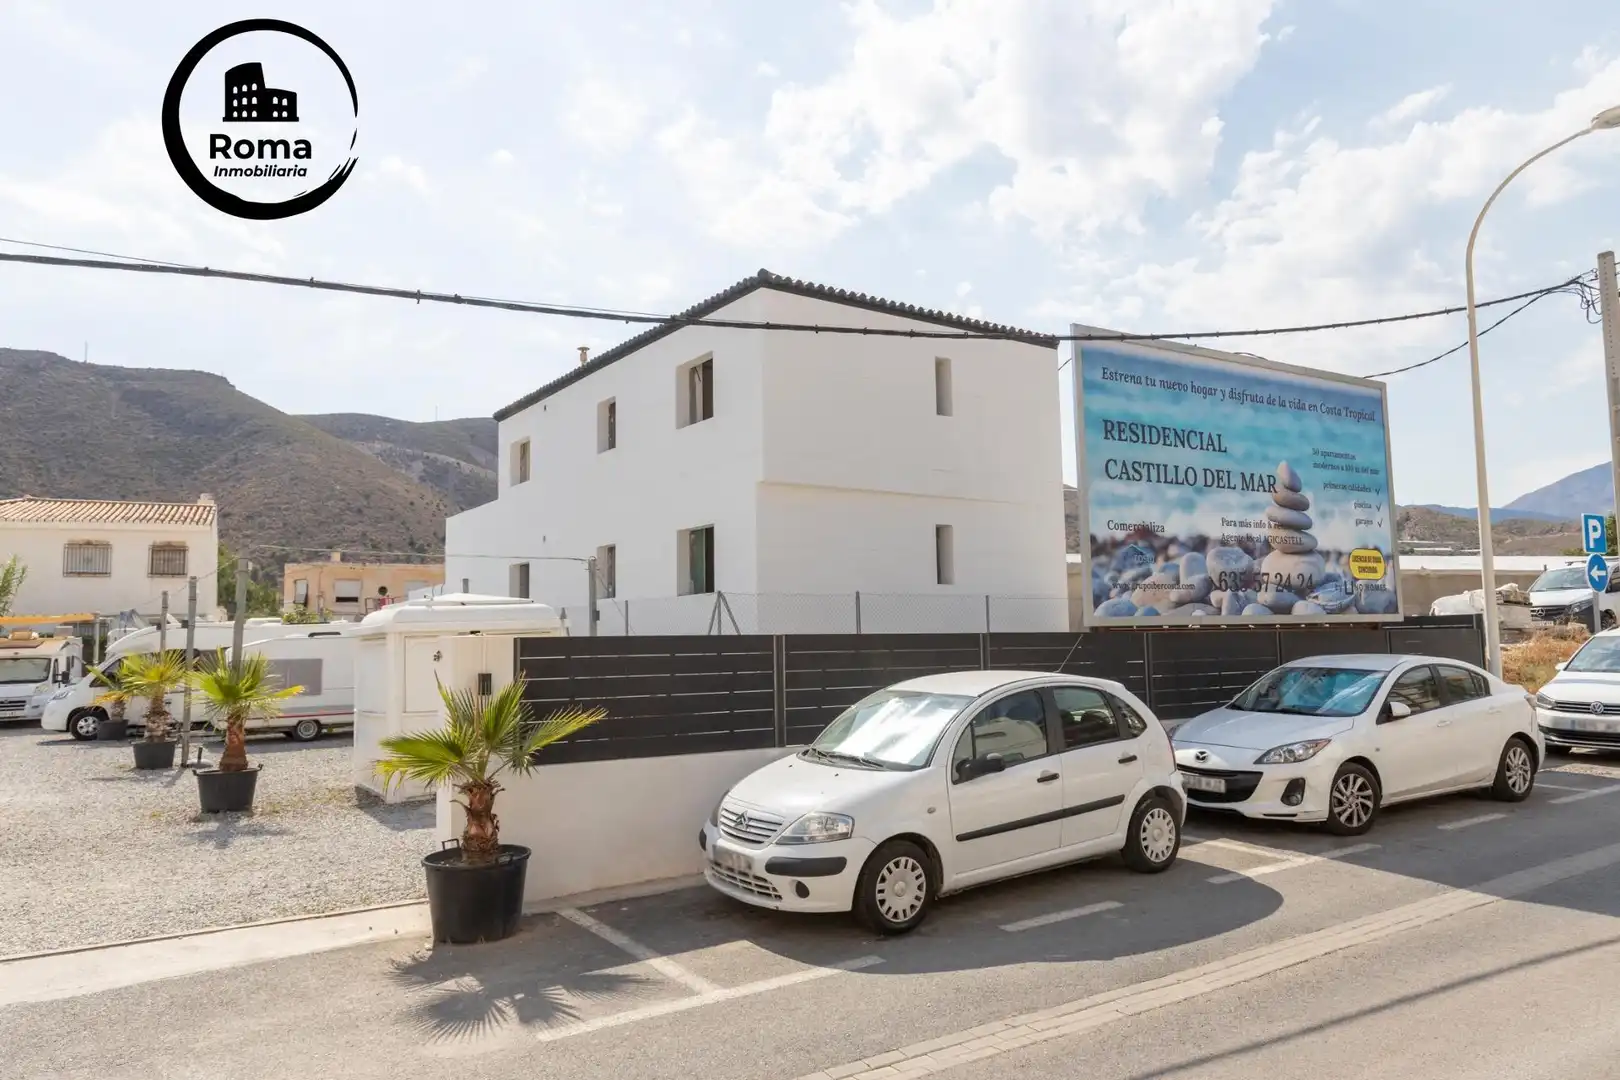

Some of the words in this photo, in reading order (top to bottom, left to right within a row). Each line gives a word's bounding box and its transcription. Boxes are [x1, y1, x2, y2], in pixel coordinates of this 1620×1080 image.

[1102, 366, 1142, 385] Estrena
[1145, 375, 1156, 387] tu
[1159, 379, 1188, 392] nuevo
[1191, 381, 1217, 399] hogar
[1220, 388, 1226, 401] y
[1228, 388, 1264, 404] disfruta
[1266, 393, 1276, 406] de
[1278, 395, 1286, 407] la
[1288, 398, 1306, 411] vida
[1320, 403, 1342, 416] Costa
[1343, 407, 1375, 423] Tropical
[1102, 419, 1227, 453] RESIDENCIAL
[1320, 450, 1356, 461] apartamentos
[1312, 462, 1339, 472] modernos
[1105, 458, 1197, 487] CASTILLO
[1202, 468, 1236, 490] DEL
[1240, 471, 1278, 494] MAR
[1323, 481, 1347, 491] primeras
[1348, 483, 1372, 493] calidades
[1107, 519, 1165, 533] Comercializa
[1221, 517, 1237, 527] Para
[1253, 519, 1266, 529] info
[1221, 533, 1245, 544] Agente
[1587, 519, 1602, 549] P
[1274, 572, 1292, 593] 24
[1297, 573, 1314, 592] 24
